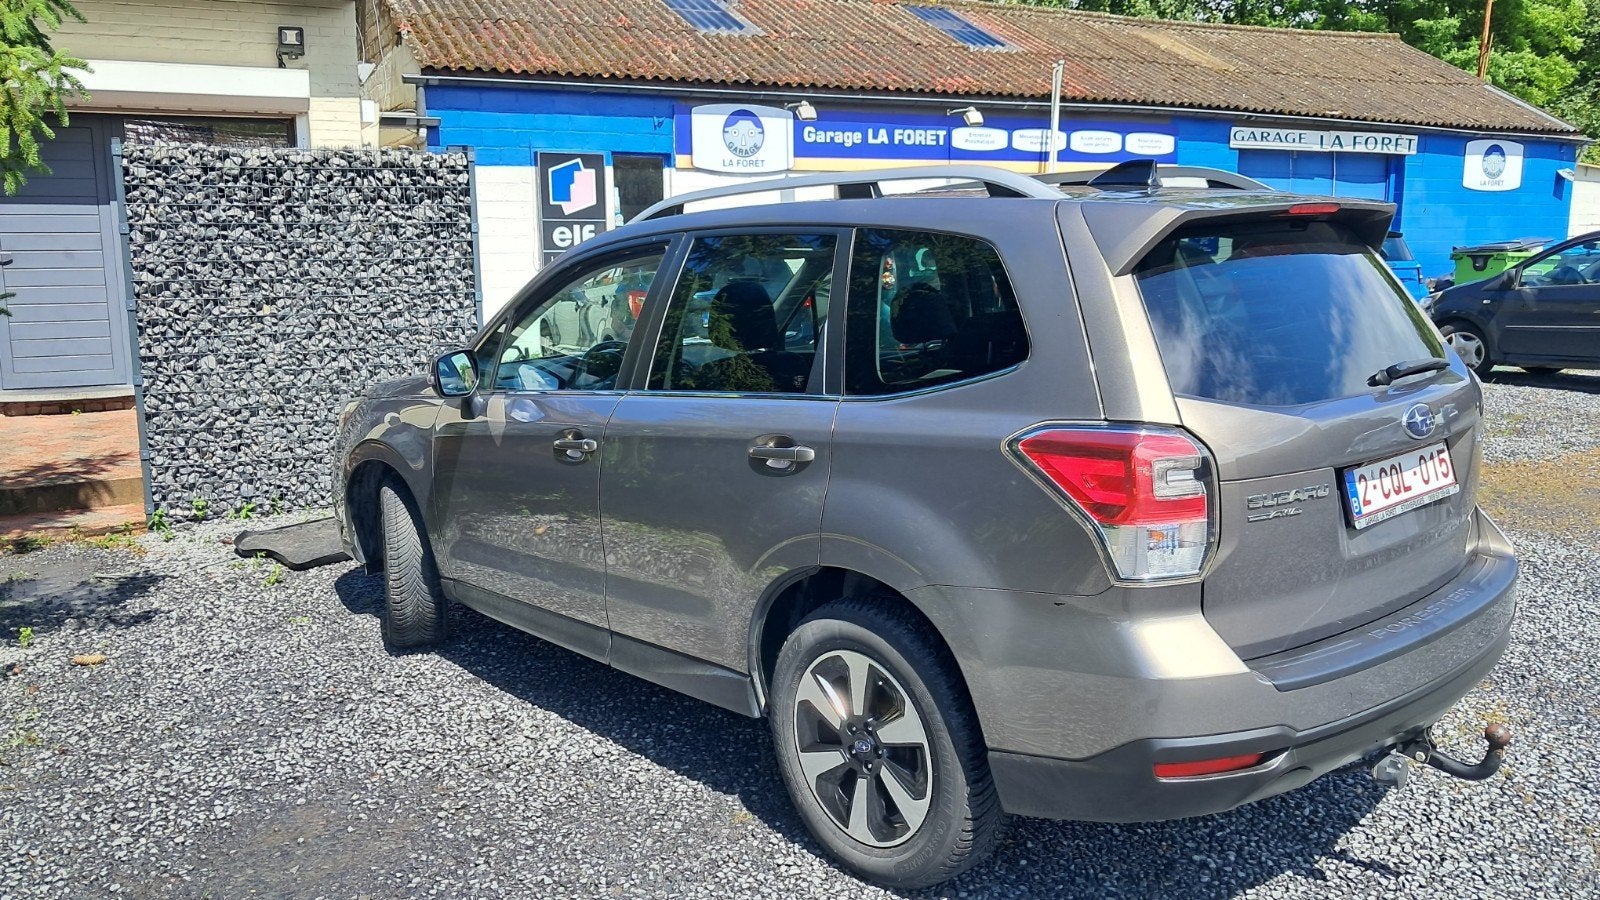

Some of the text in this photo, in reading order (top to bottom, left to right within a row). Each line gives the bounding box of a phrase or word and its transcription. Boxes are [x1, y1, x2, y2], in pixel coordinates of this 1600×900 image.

[803, 126, 947, 147] Garage LA FORET
[1233, 129, 1416, 151] GARAGE LA FORÊT
[727, 141, 761, 156] GARAGE
[722, 159, 734, 167] LA
[552, 224, 596, 248] elf
[1246, 483, 1330, 510] SUBARU
[1351, 497, 1360, 513] B
[1368, 587, 1474, 639] FORESTER
